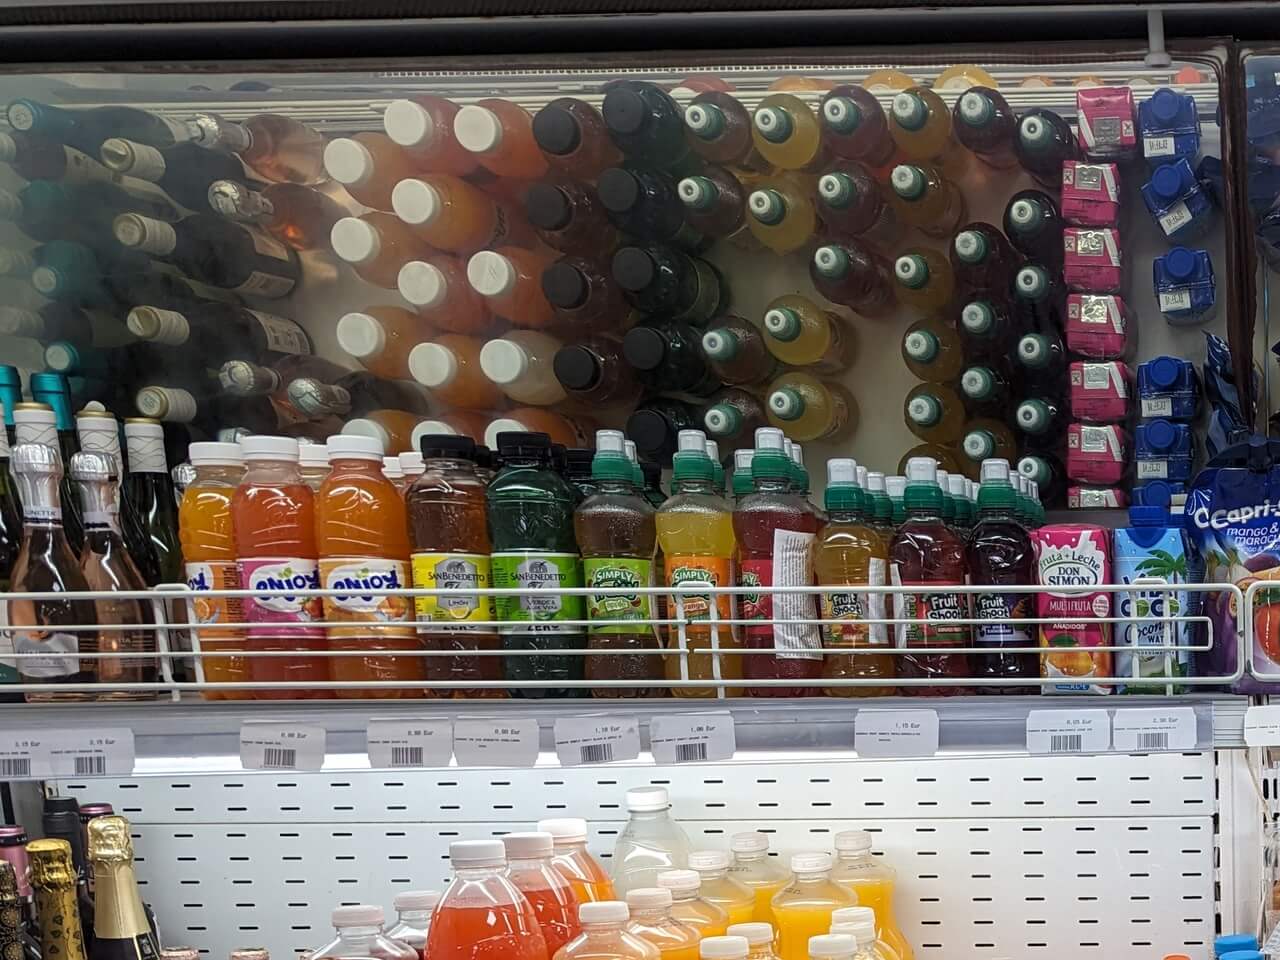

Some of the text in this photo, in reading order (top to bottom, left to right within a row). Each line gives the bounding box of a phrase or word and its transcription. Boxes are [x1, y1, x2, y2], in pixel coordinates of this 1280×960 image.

[597, 569, 633, 581] SIMPLY
[673, 569, 710, 581] SIMPLY
[1058, 567, 1080, 575] DON
[1048, 576, 1090, 586] SIMON
